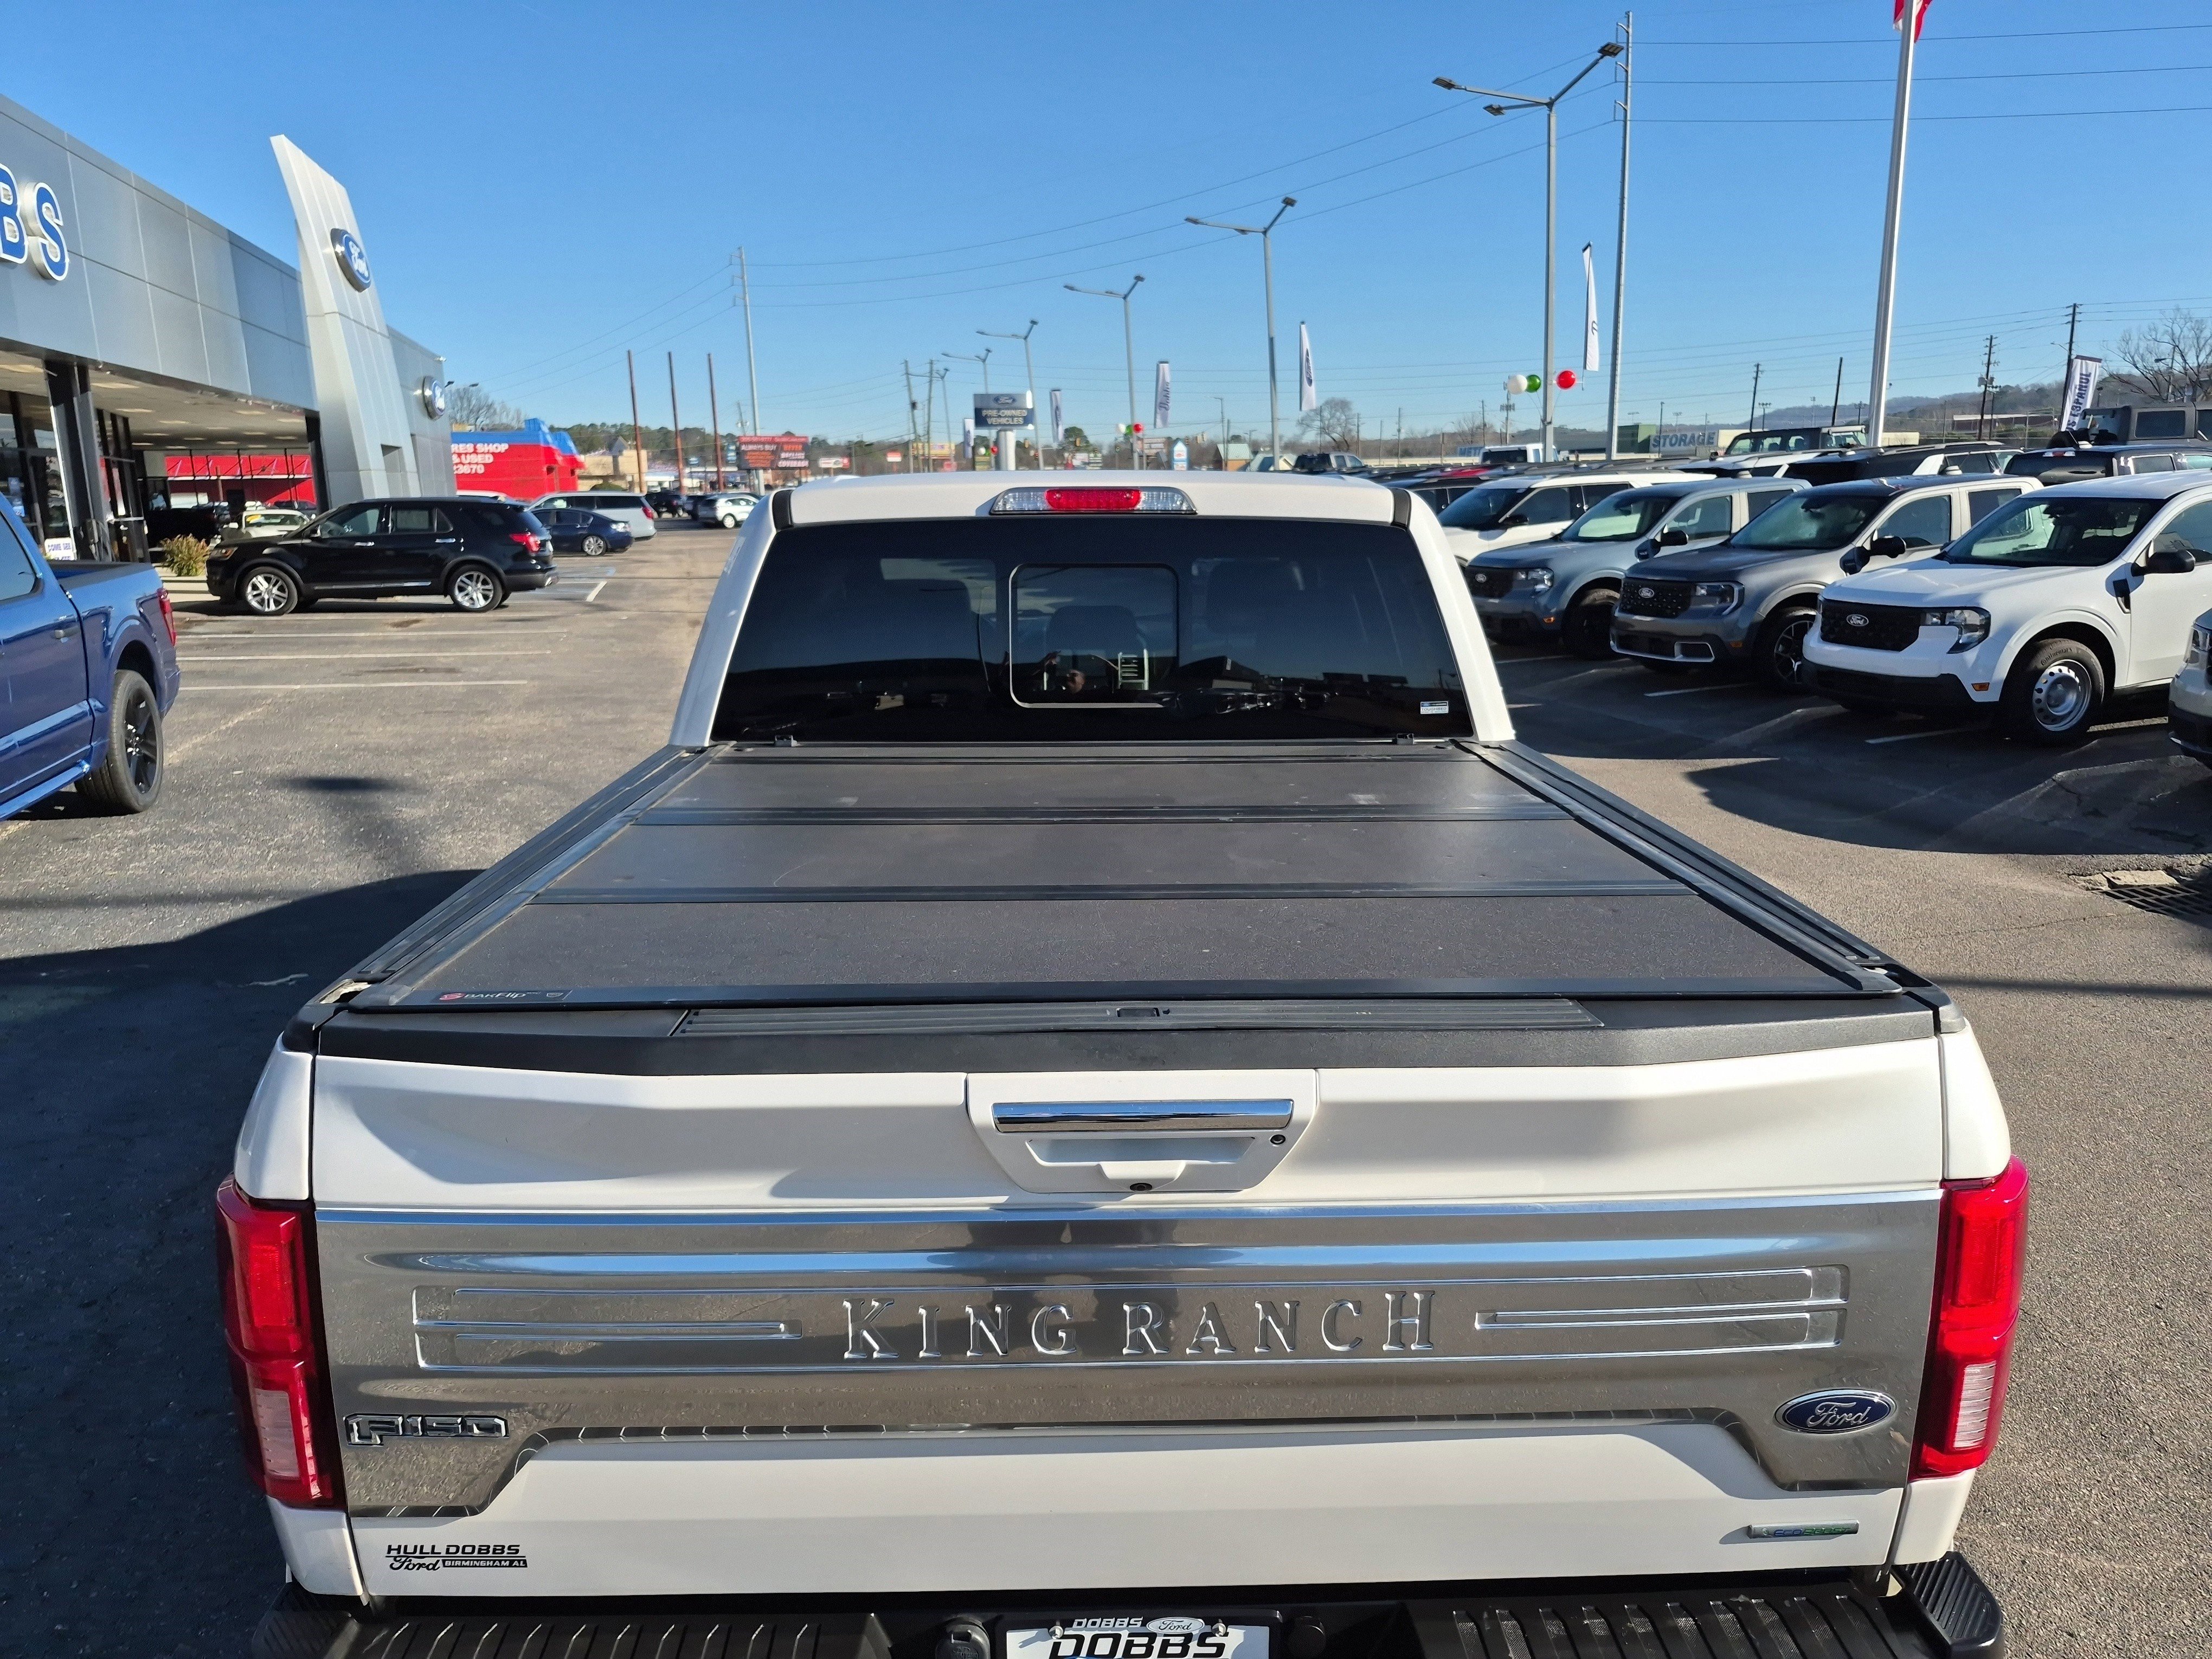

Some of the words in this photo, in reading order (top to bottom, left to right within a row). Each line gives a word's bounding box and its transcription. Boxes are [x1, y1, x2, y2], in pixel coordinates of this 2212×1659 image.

[349, 241, 369, 278] Ford
[476, 442, 509, 453] SHOP
[1652, 432, 1716, 448] STORAGE
[461, 453, 494, 464] USED
[1850, 615, 1864, 624] Ford
[843, 1298, 1077, 1359] KING
[1122, 1290, 1435, 1355] RANCH
[1806, 1402, 1872, 1427] Ford
[387, 1545, 442, 1555] HULL
[445, 1545, 520, 1555] DOBBS
[389, 1555, 441, 1571] Ford
[1072, 1617, 1143, 1629] DOBBS
[1158, 1619, 1192, 1631] Ford
[1049, 1631, 1230, 1659] DOBBS
